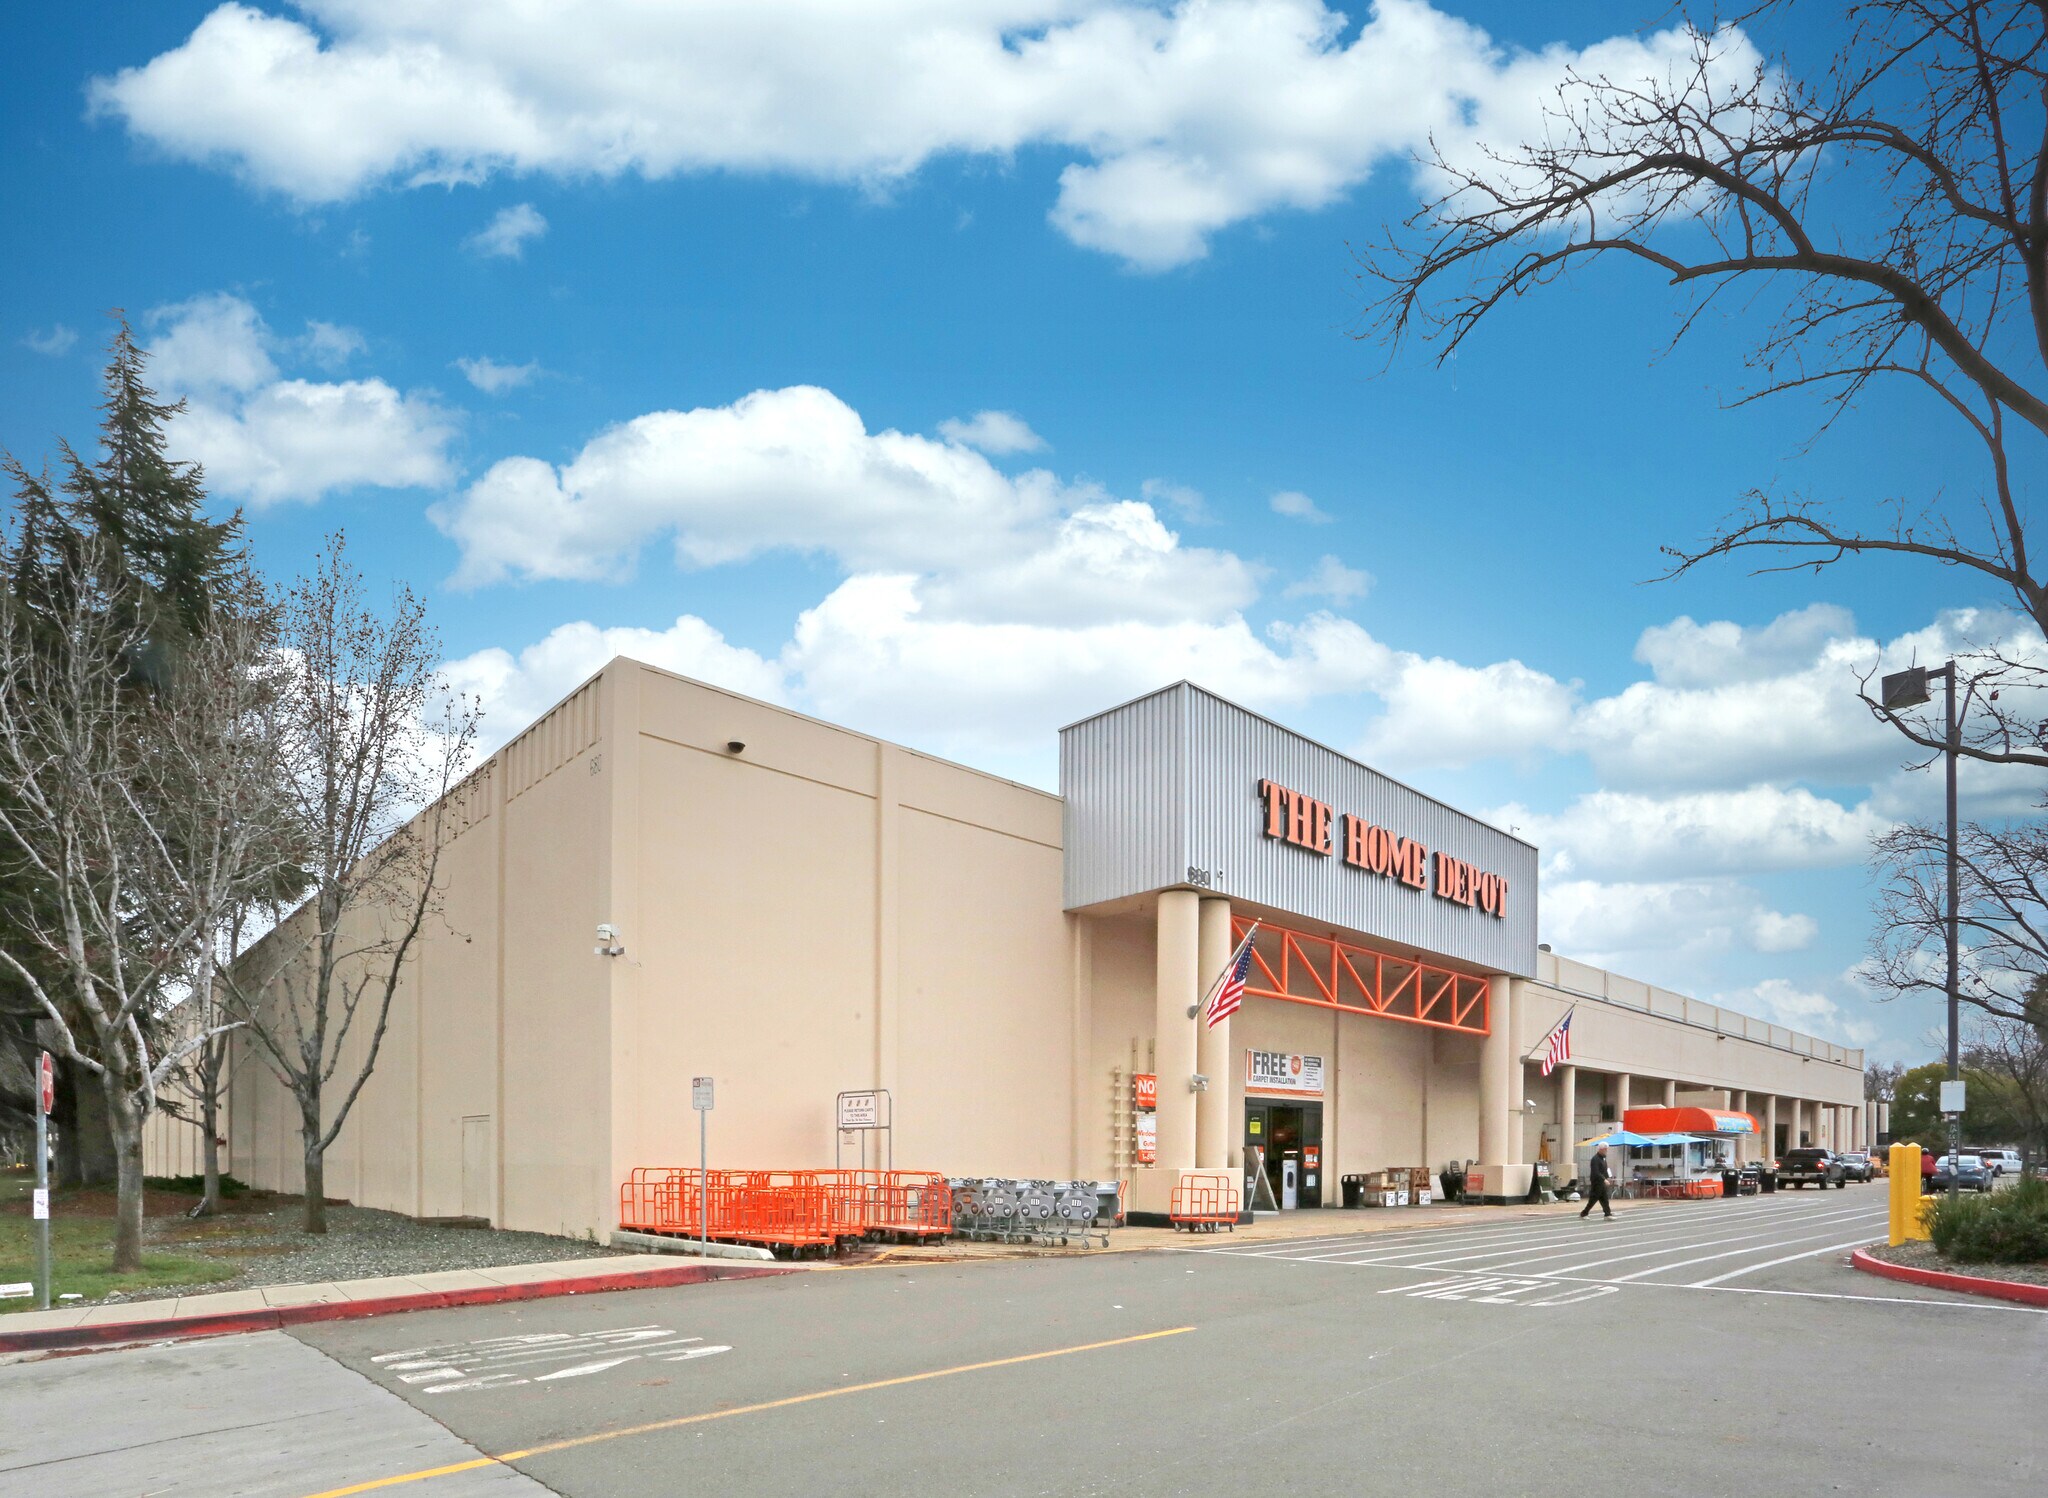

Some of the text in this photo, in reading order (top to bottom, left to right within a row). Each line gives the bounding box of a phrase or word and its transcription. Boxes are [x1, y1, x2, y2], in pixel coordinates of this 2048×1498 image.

[1259, 778, 1509, 918] THE HOME DEPOT
[1253, 1051, 1287, 1077] FREE
[1138, 1080, 1156, 1094] NO
[1253, 1075, 1269, 1084] CARPET
[1269, 1076, 1296, 1085] INSTALLATION
[1376, 1275, 1620, 1307] YIELD
[370, 1324, 734, 1394] STOP
